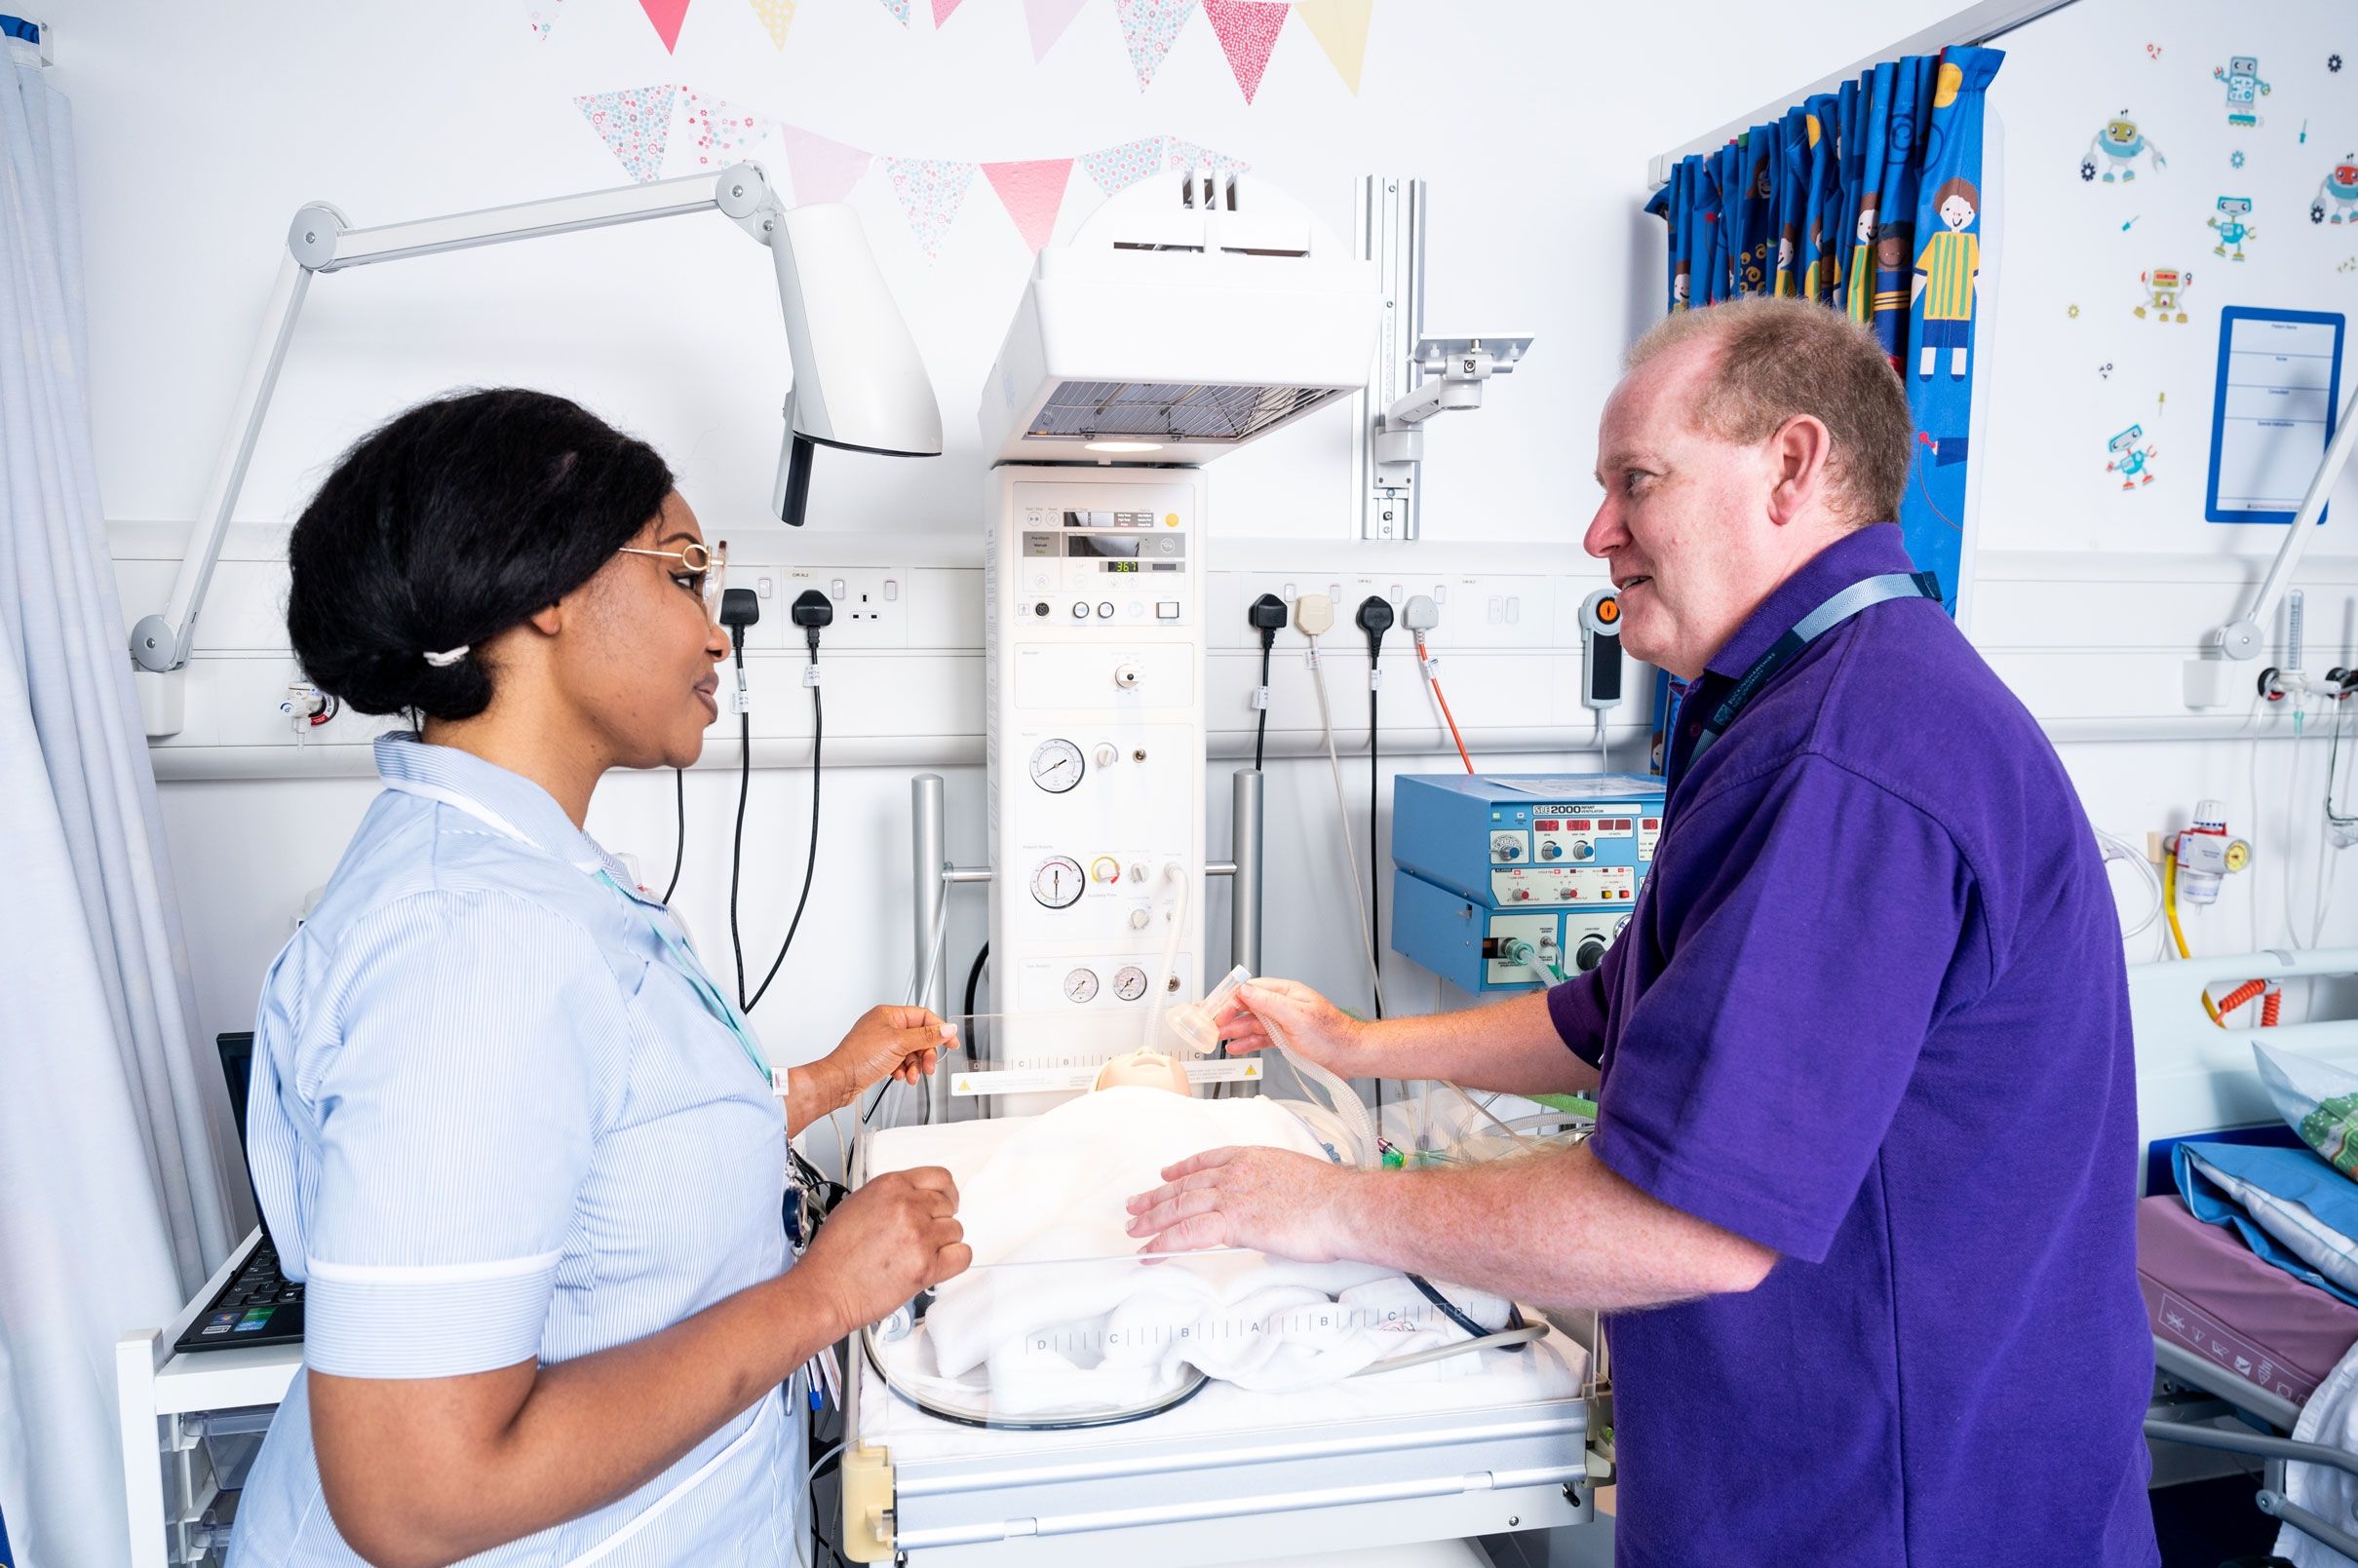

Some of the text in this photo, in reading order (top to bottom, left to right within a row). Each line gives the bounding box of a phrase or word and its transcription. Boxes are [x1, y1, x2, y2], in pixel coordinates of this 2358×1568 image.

[1037, 1340, 1047, 1351] D
[1109, 1333, 1119, 1344] C
[1180, 1327, 1190, 1338] B
[1251, 1322, 1260, 1333] A
[1320, 1317, 1330, 1327] B
[1388, 1311, 1397, 1321] C
